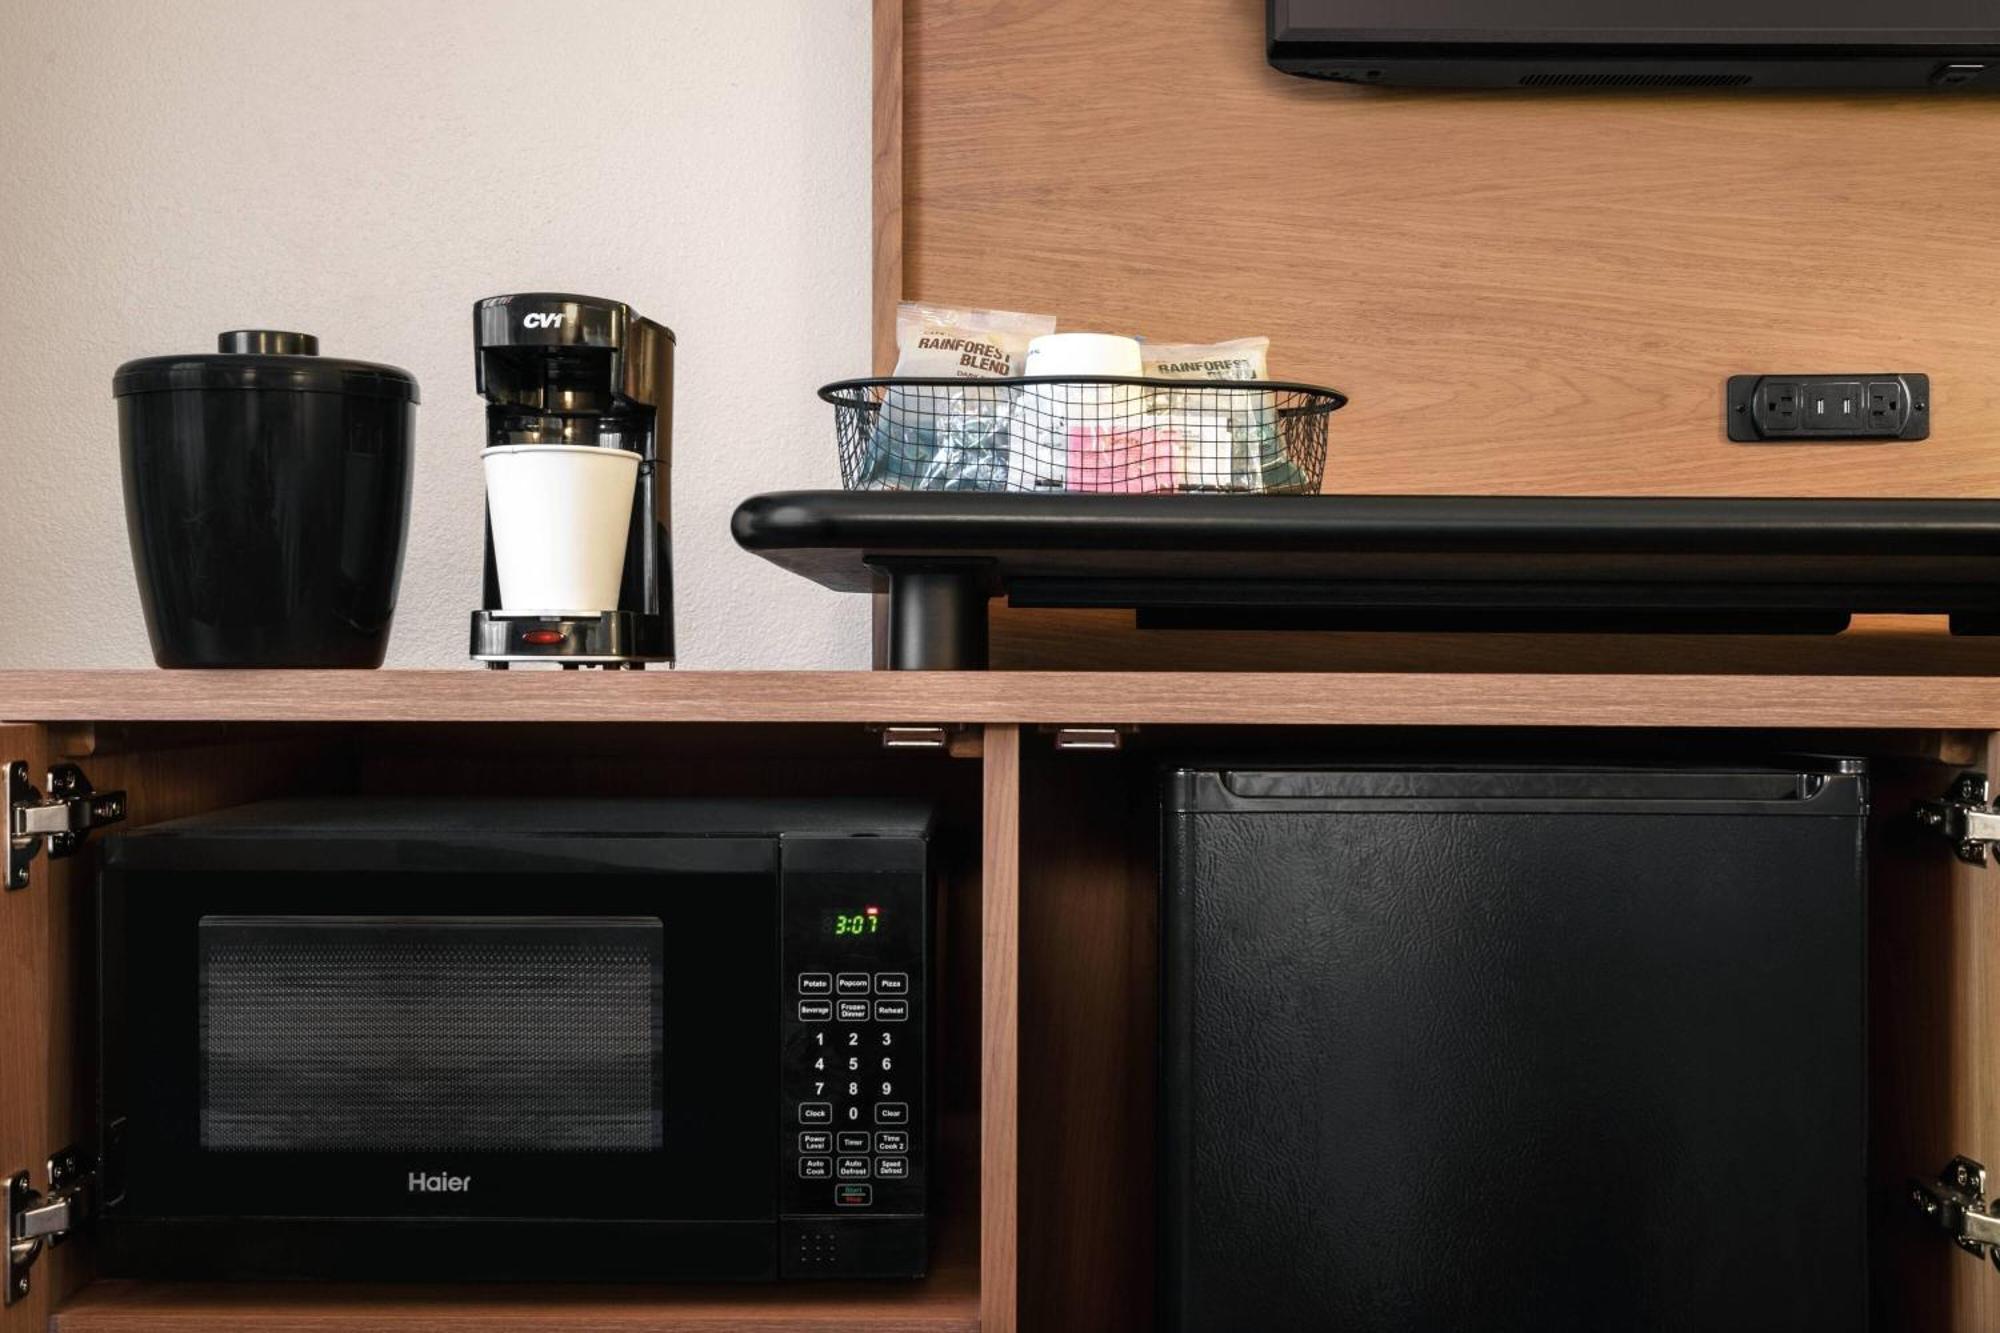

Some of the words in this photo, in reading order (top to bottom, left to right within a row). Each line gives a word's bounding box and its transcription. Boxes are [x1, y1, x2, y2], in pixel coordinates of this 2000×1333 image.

[523, 313, 566, 328] CV1
[959, 353, 1010, 376] BLEND
[836, 915, 878, 934] 3:07
[803, 979, 827, 987] Potato
[839, 979, 868, 988] Popcorn
[801, 1006, 829, 1015] Beverage
[878, 1006, 904, 1014] Reheat
[816, 1032, 824, 1045] 1
[849, 1033, 858, 1045] 2
[882, 1033, 891, 1045] 3
[814, 1058, 824, 1070] 4
[849, 1058, 858, 1070] 5
[882, 1058, 891, 1070] 6
[815, 1082, 824, 1095] 7
[849, 1082, 858, 1095] 8
[882, 1082, 891, 1095] 9
[849, 1107, 858, 1120] 0
[408, 1171, 471, 1191] Haier
